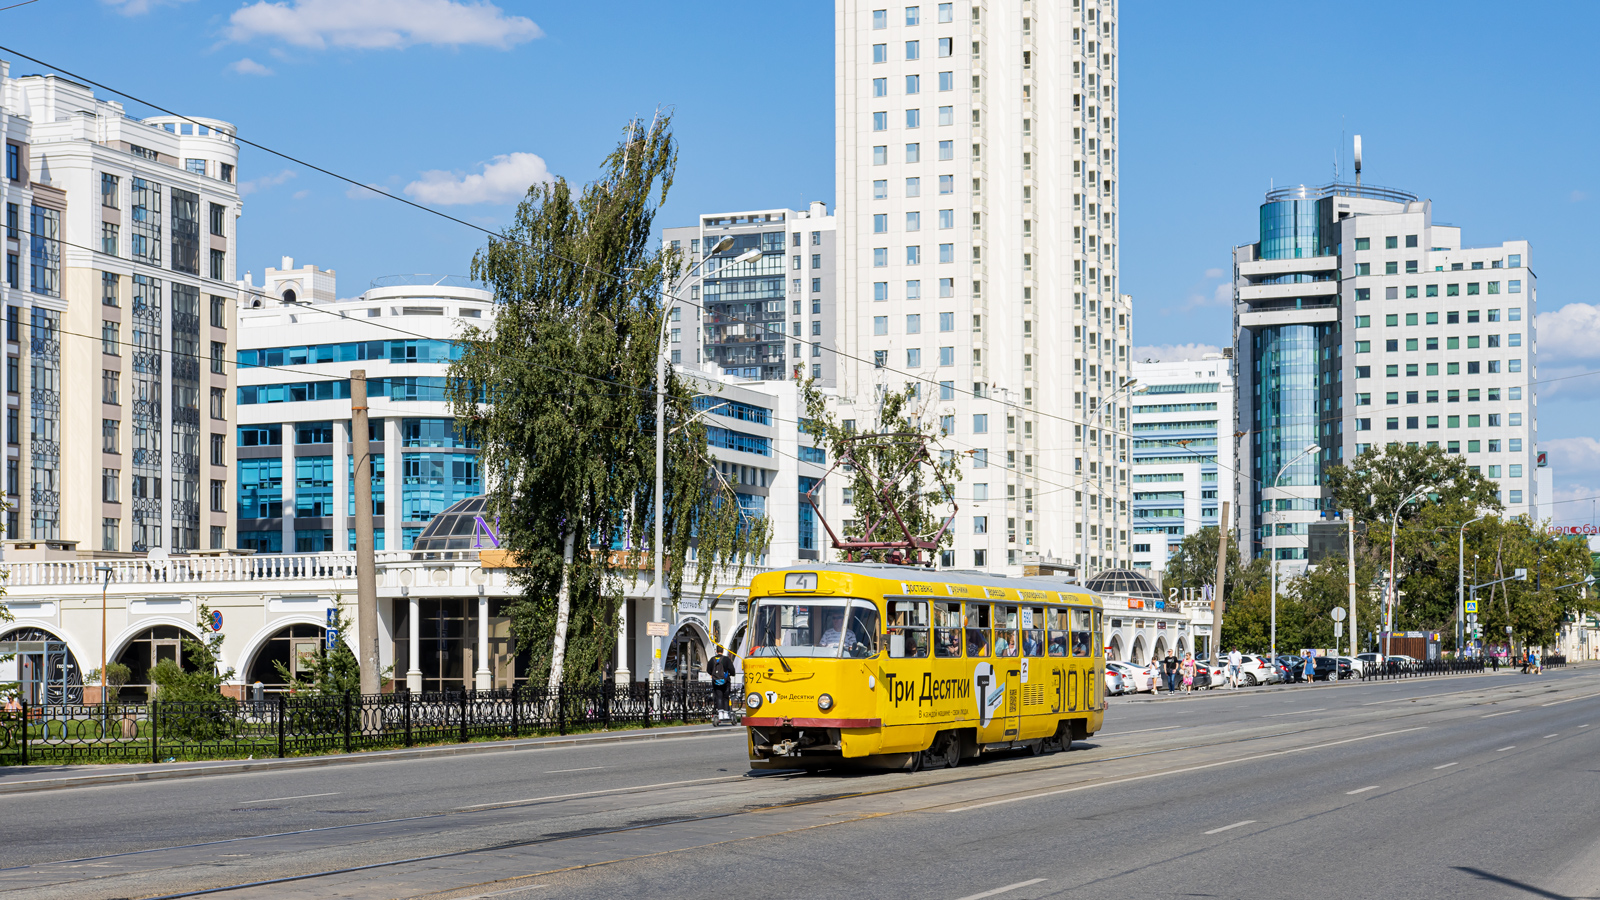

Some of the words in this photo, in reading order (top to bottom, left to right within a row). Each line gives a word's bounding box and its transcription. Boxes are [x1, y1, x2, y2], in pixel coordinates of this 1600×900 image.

[1548, 523, 1600, 535] делоба
[796, 575, 807, 589] 4
[886, 673, 914, 708] Три
[919, 672, 970, 707] Десятки
